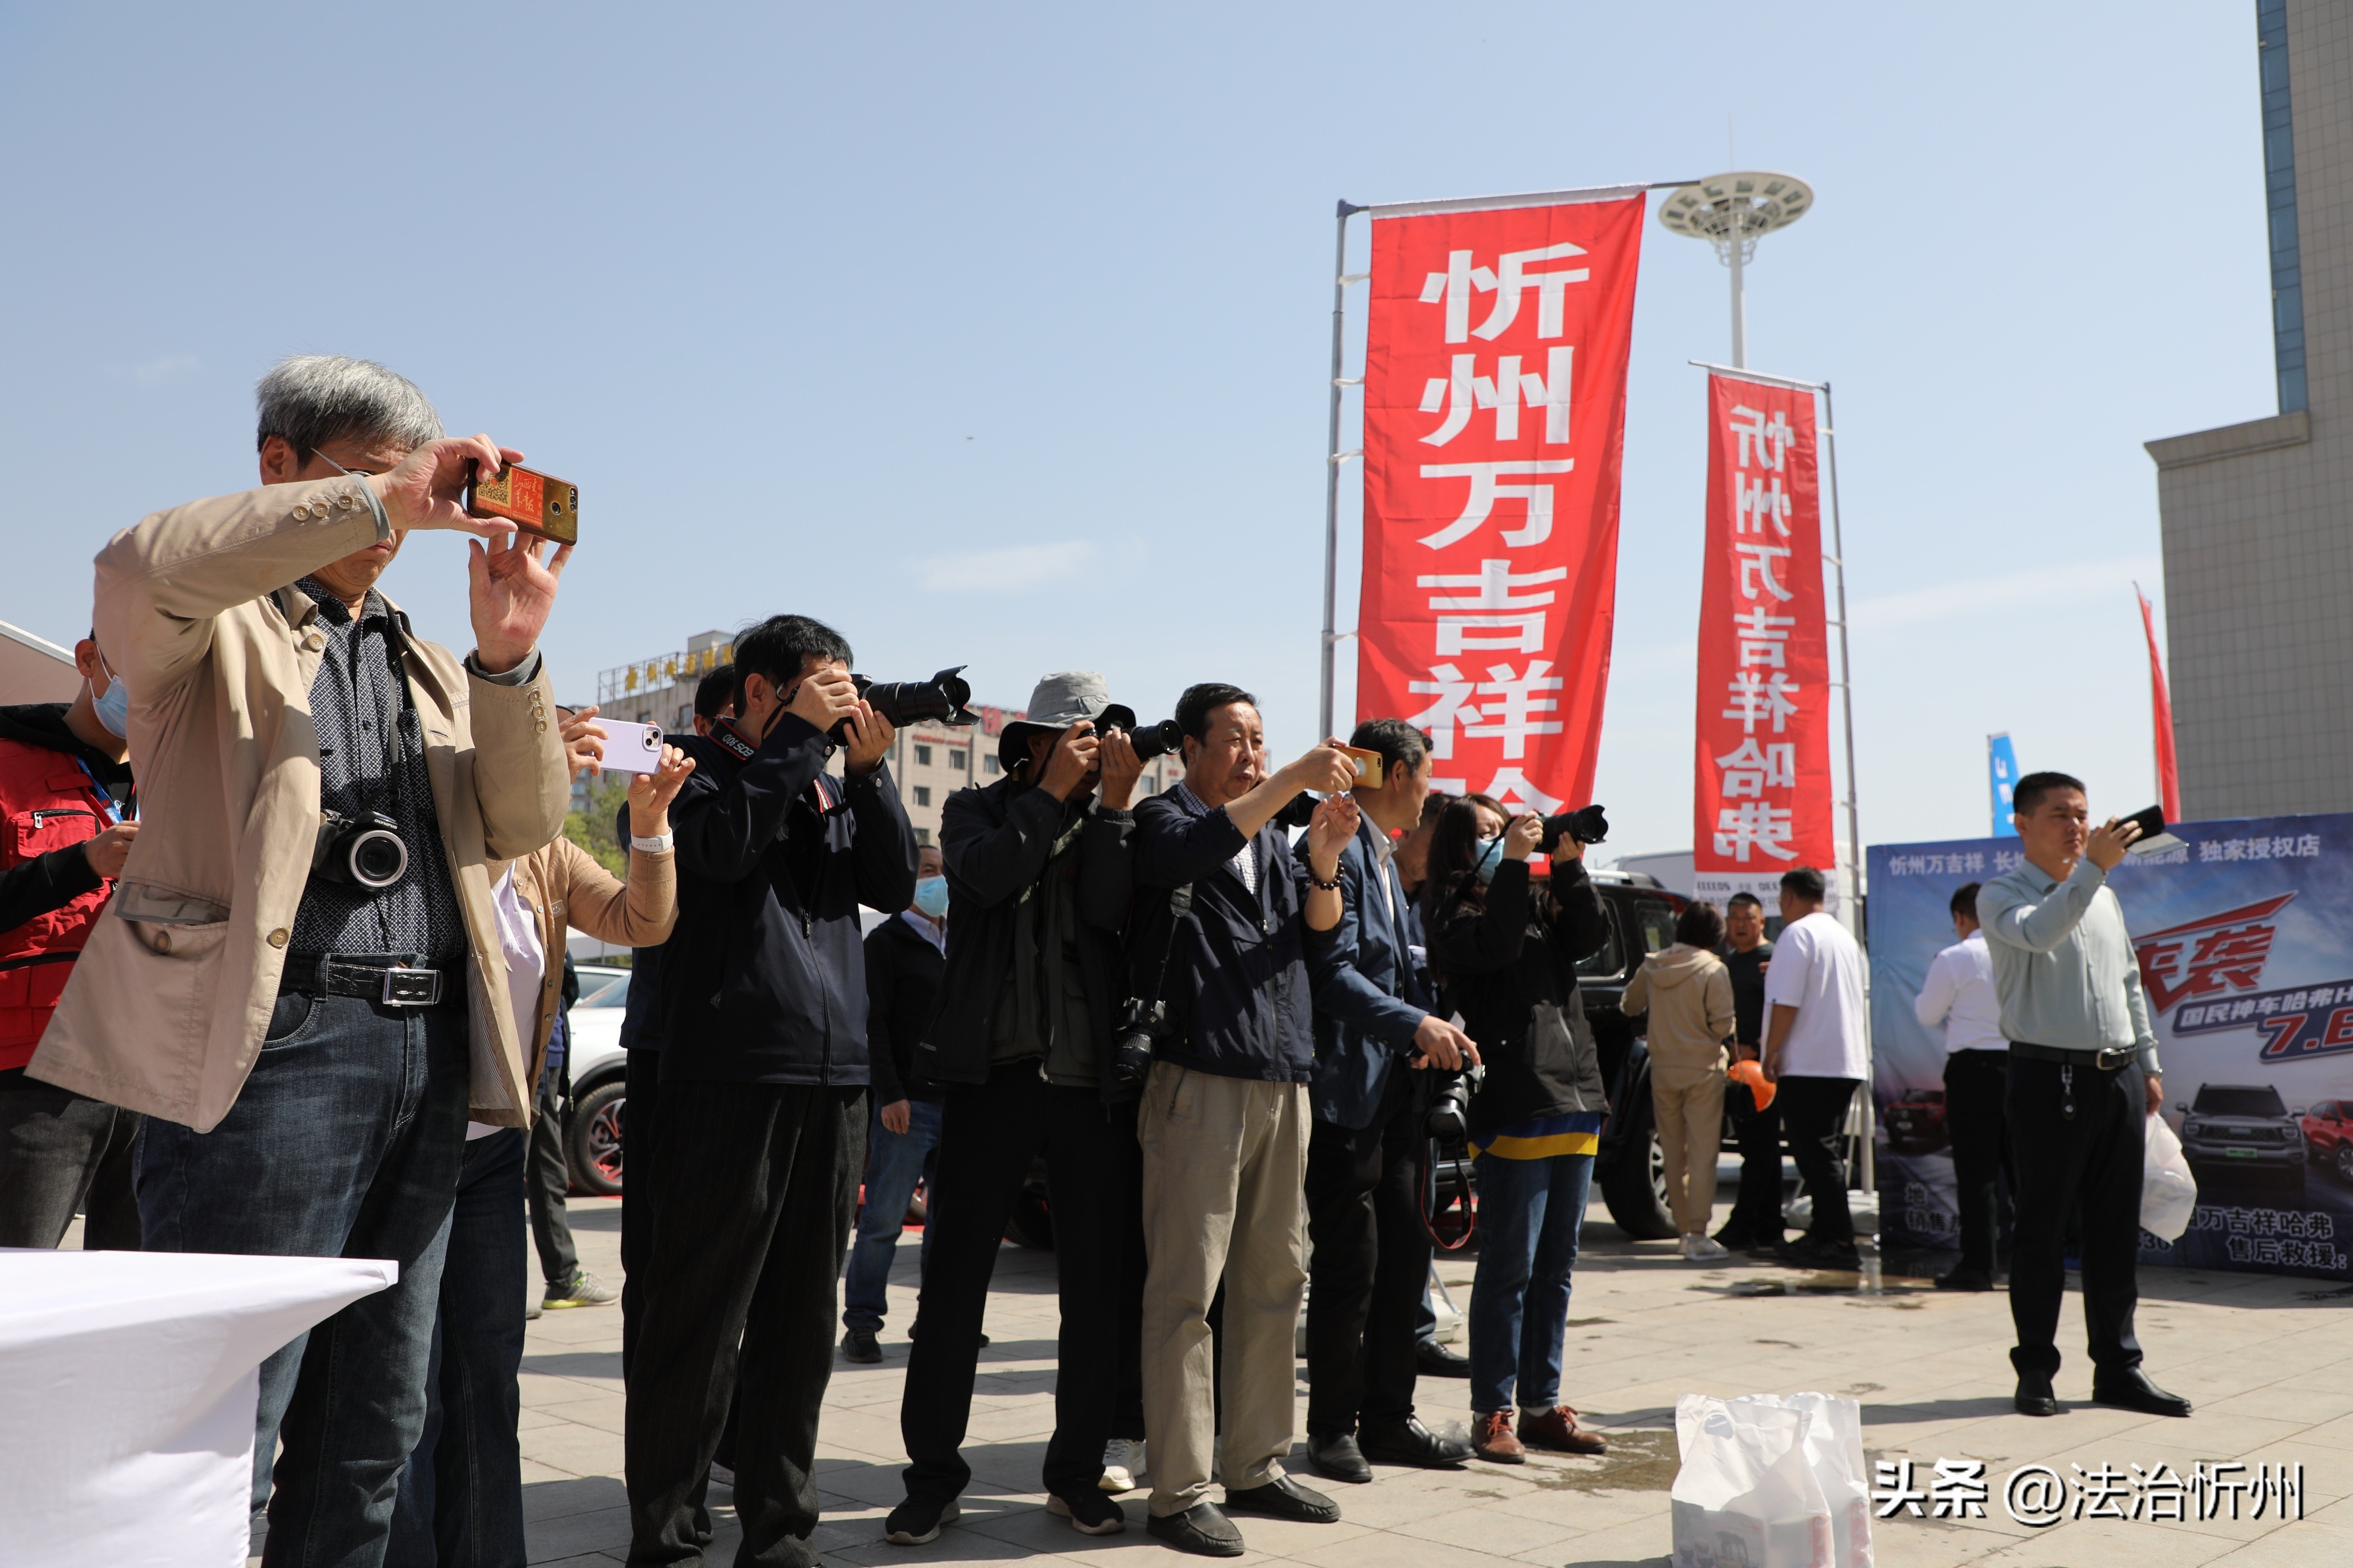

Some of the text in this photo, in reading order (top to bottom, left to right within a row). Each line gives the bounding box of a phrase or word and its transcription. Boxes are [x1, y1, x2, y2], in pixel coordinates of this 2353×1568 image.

[733, 743, 754, 757] EOS
[374, 819, 398, 829] OLYMPUS
[1889, 853, 1985, 876] 忻州万吉祥
[2199, 834, 2320, 862] 独家授权店
